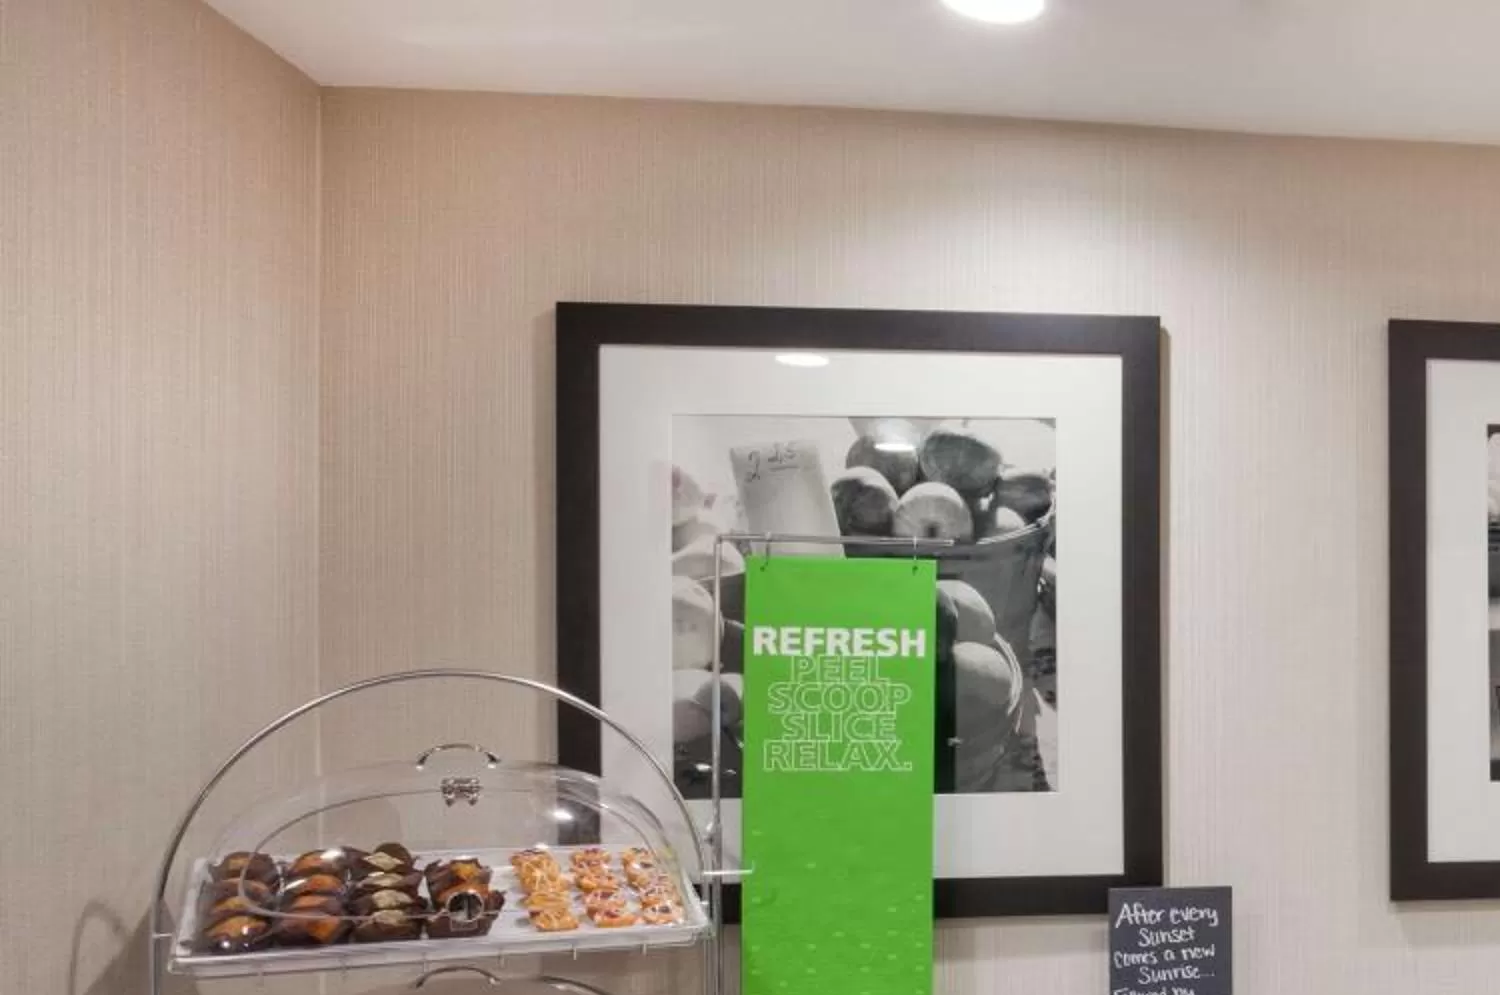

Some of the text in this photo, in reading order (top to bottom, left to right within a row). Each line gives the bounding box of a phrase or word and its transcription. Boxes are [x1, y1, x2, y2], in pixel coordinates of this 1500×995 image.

[753, 625, 926, 657] REFRESH
[790, 655, 889, 684] PEEL
[767, 682, 912, 713] SCOOP
[782, 712, 897, 741] SLICE
[763, 740, 913, 771] RELAX.
[1115, 902, 1219, 929] After every
[1137, 927, 1196, 947] Sunset
[1163, 950, 1175, 961] a
[1181, 944, 1217, 961] new
